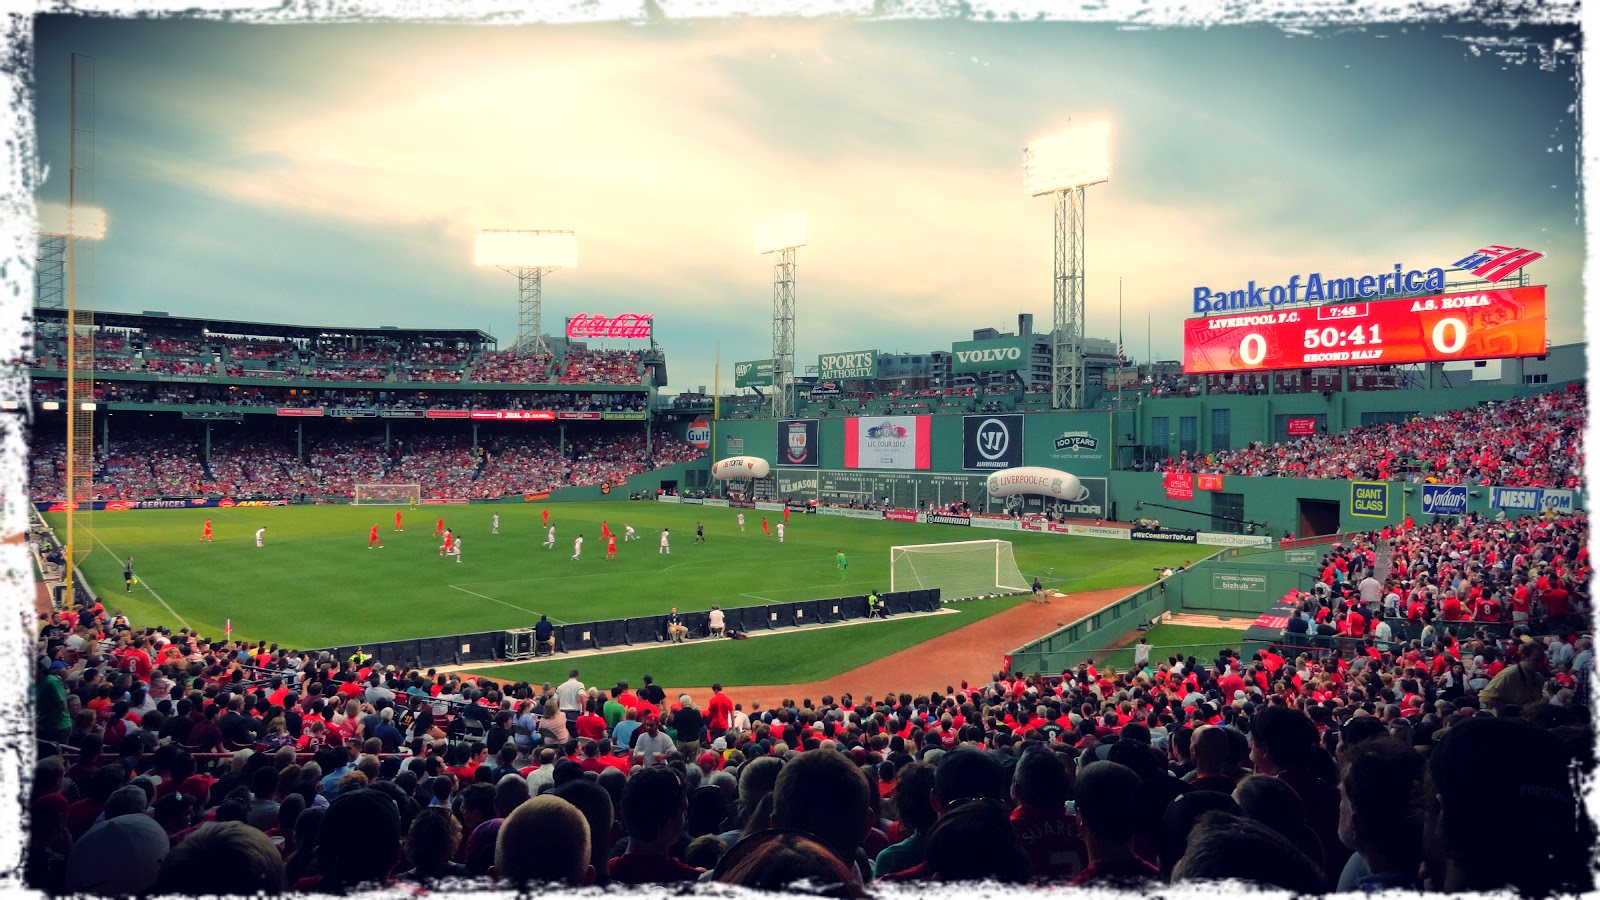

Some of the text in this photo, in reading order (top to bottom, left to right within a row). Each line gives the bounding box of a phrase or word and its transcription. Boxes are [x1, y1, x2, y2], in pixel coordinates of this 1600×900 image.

[1193, 264, 1445, 313] Bank of America
[1410, 295, 1491, 312] A.S. ROMA
[1329, 306, 1356, 317] 7:48
[566, 312, 654, 339] Coca-Cola
[1208, 312, 1301, 329] LIVERPOOL F.C.
[1303, 323, 1382, 349] 50:41
[1431, 317, 1467, 354] 0
[955, 347, 1021, 363] VOLVO
[1239, 333, 1267, 365] 0
[1303, 349, 1383, 364] SECOND HALF
[821, 352, 872, 371] SPORTS
[687, 429, 710, 441] Gulf
[1057, 437, 1095, 447] 100 YEARS
[1000, 475, 1049, 487] LIVERPOOL FC
[1166, 487, 1193, 497] SUSPECTS
[1356, 488, 1382, 499] GIANT
[1499, 490, 1536, 508] NESN
[1355, 499, 1383, 511] GLASS
[1427, 487, 1466, 513] Jordan's
[1052, 503, 1101, 514] HYUNDAI
[934, 516, 970, 526] WARRIOR
[971, 517, 1012, 528] Standard Chartered
[1197, 535, 1262, 545] Standard Chartered
[129, 659, 137, 672] 8
[1022, 820, 1082, 844] SUARE
